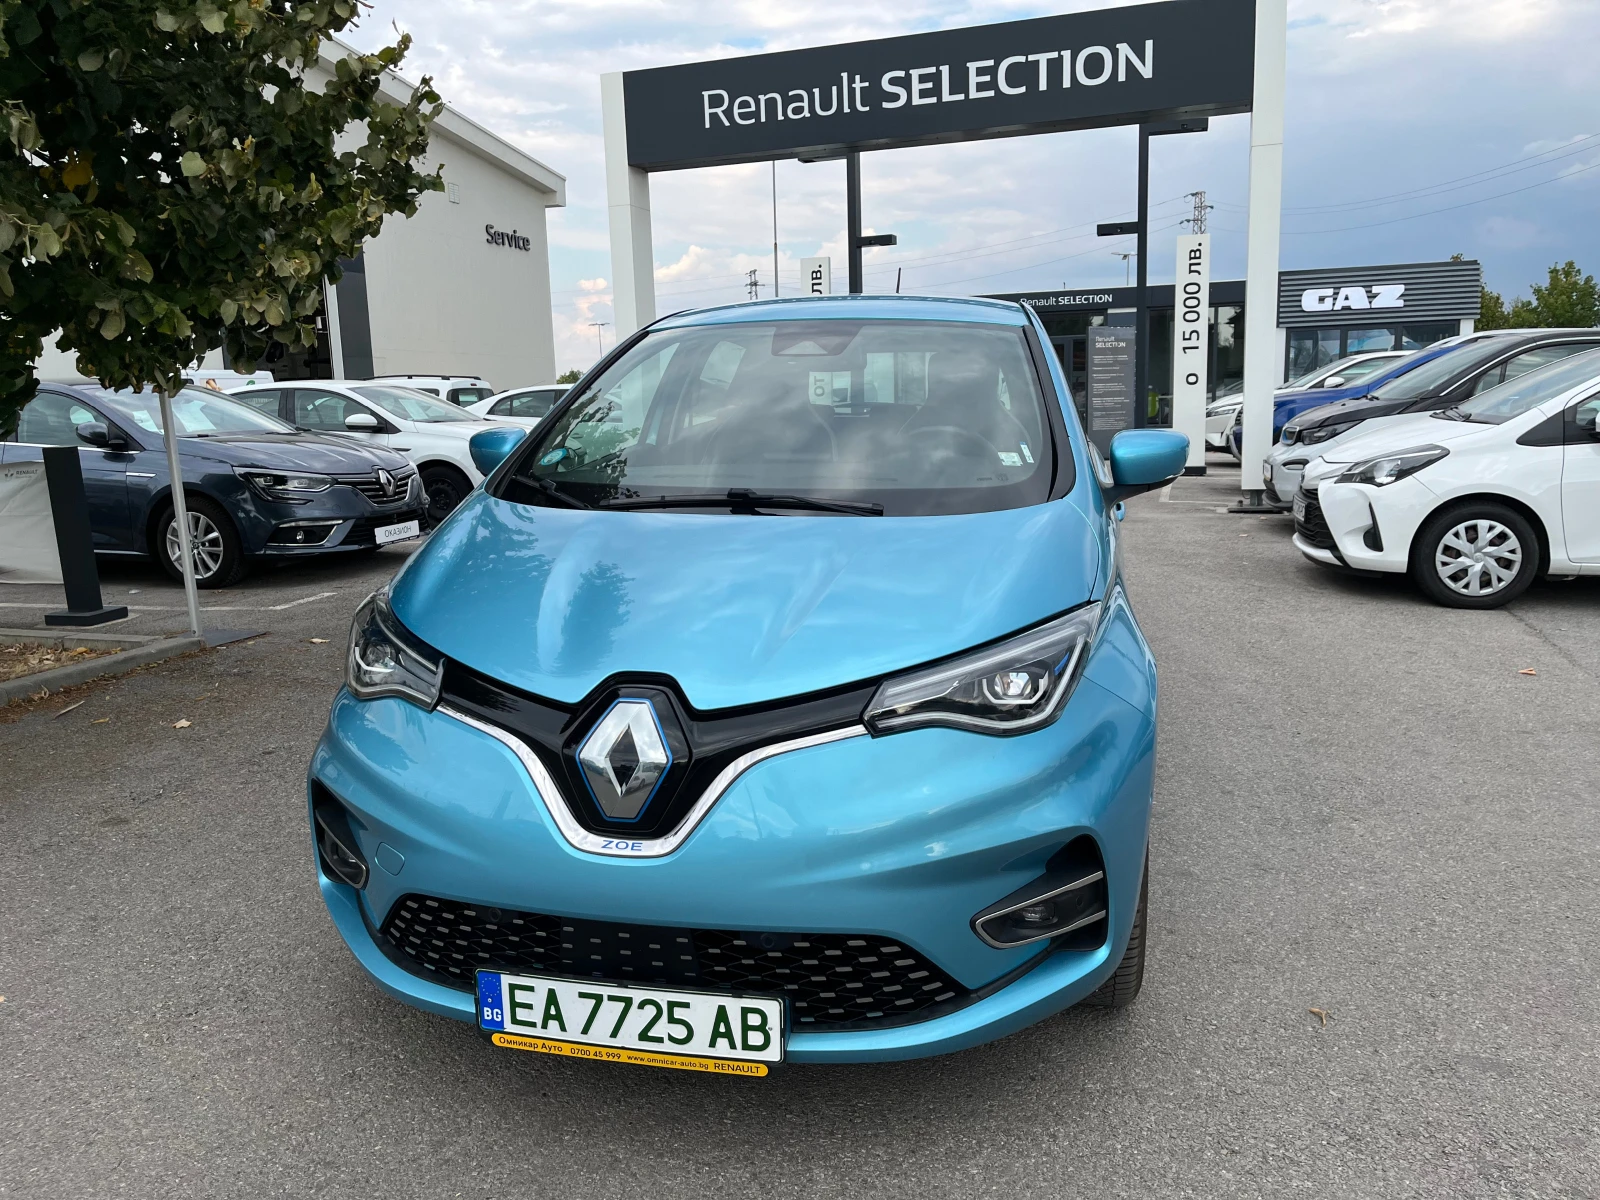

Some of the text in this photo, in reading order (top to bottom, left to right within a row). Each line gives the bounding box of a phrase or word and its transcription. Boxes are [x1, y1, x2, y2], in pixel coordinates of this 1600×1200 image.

[701, 39, 1154, 129] Renault SELECTION
[485, 223, 531, 252] Service
[1058, 294, 1113, 305] SELECTION
[1182, 282, 1201, 323] 000
[1301, 284, 1405, 312] GAZ
[1182, 329, 1200, 354] 15
[385, 525, 412, 538] ОКАЗИОН
[601, 839, 643, 852] ZOE
[483, 1006, 502, 1022] BG
[508, 982, 771, 1052] EA 7725 AB
[498, 1036, 761, 1074] Омникар Ауто 0700 45 999 www.omnicar-auto.bg RENAULT
